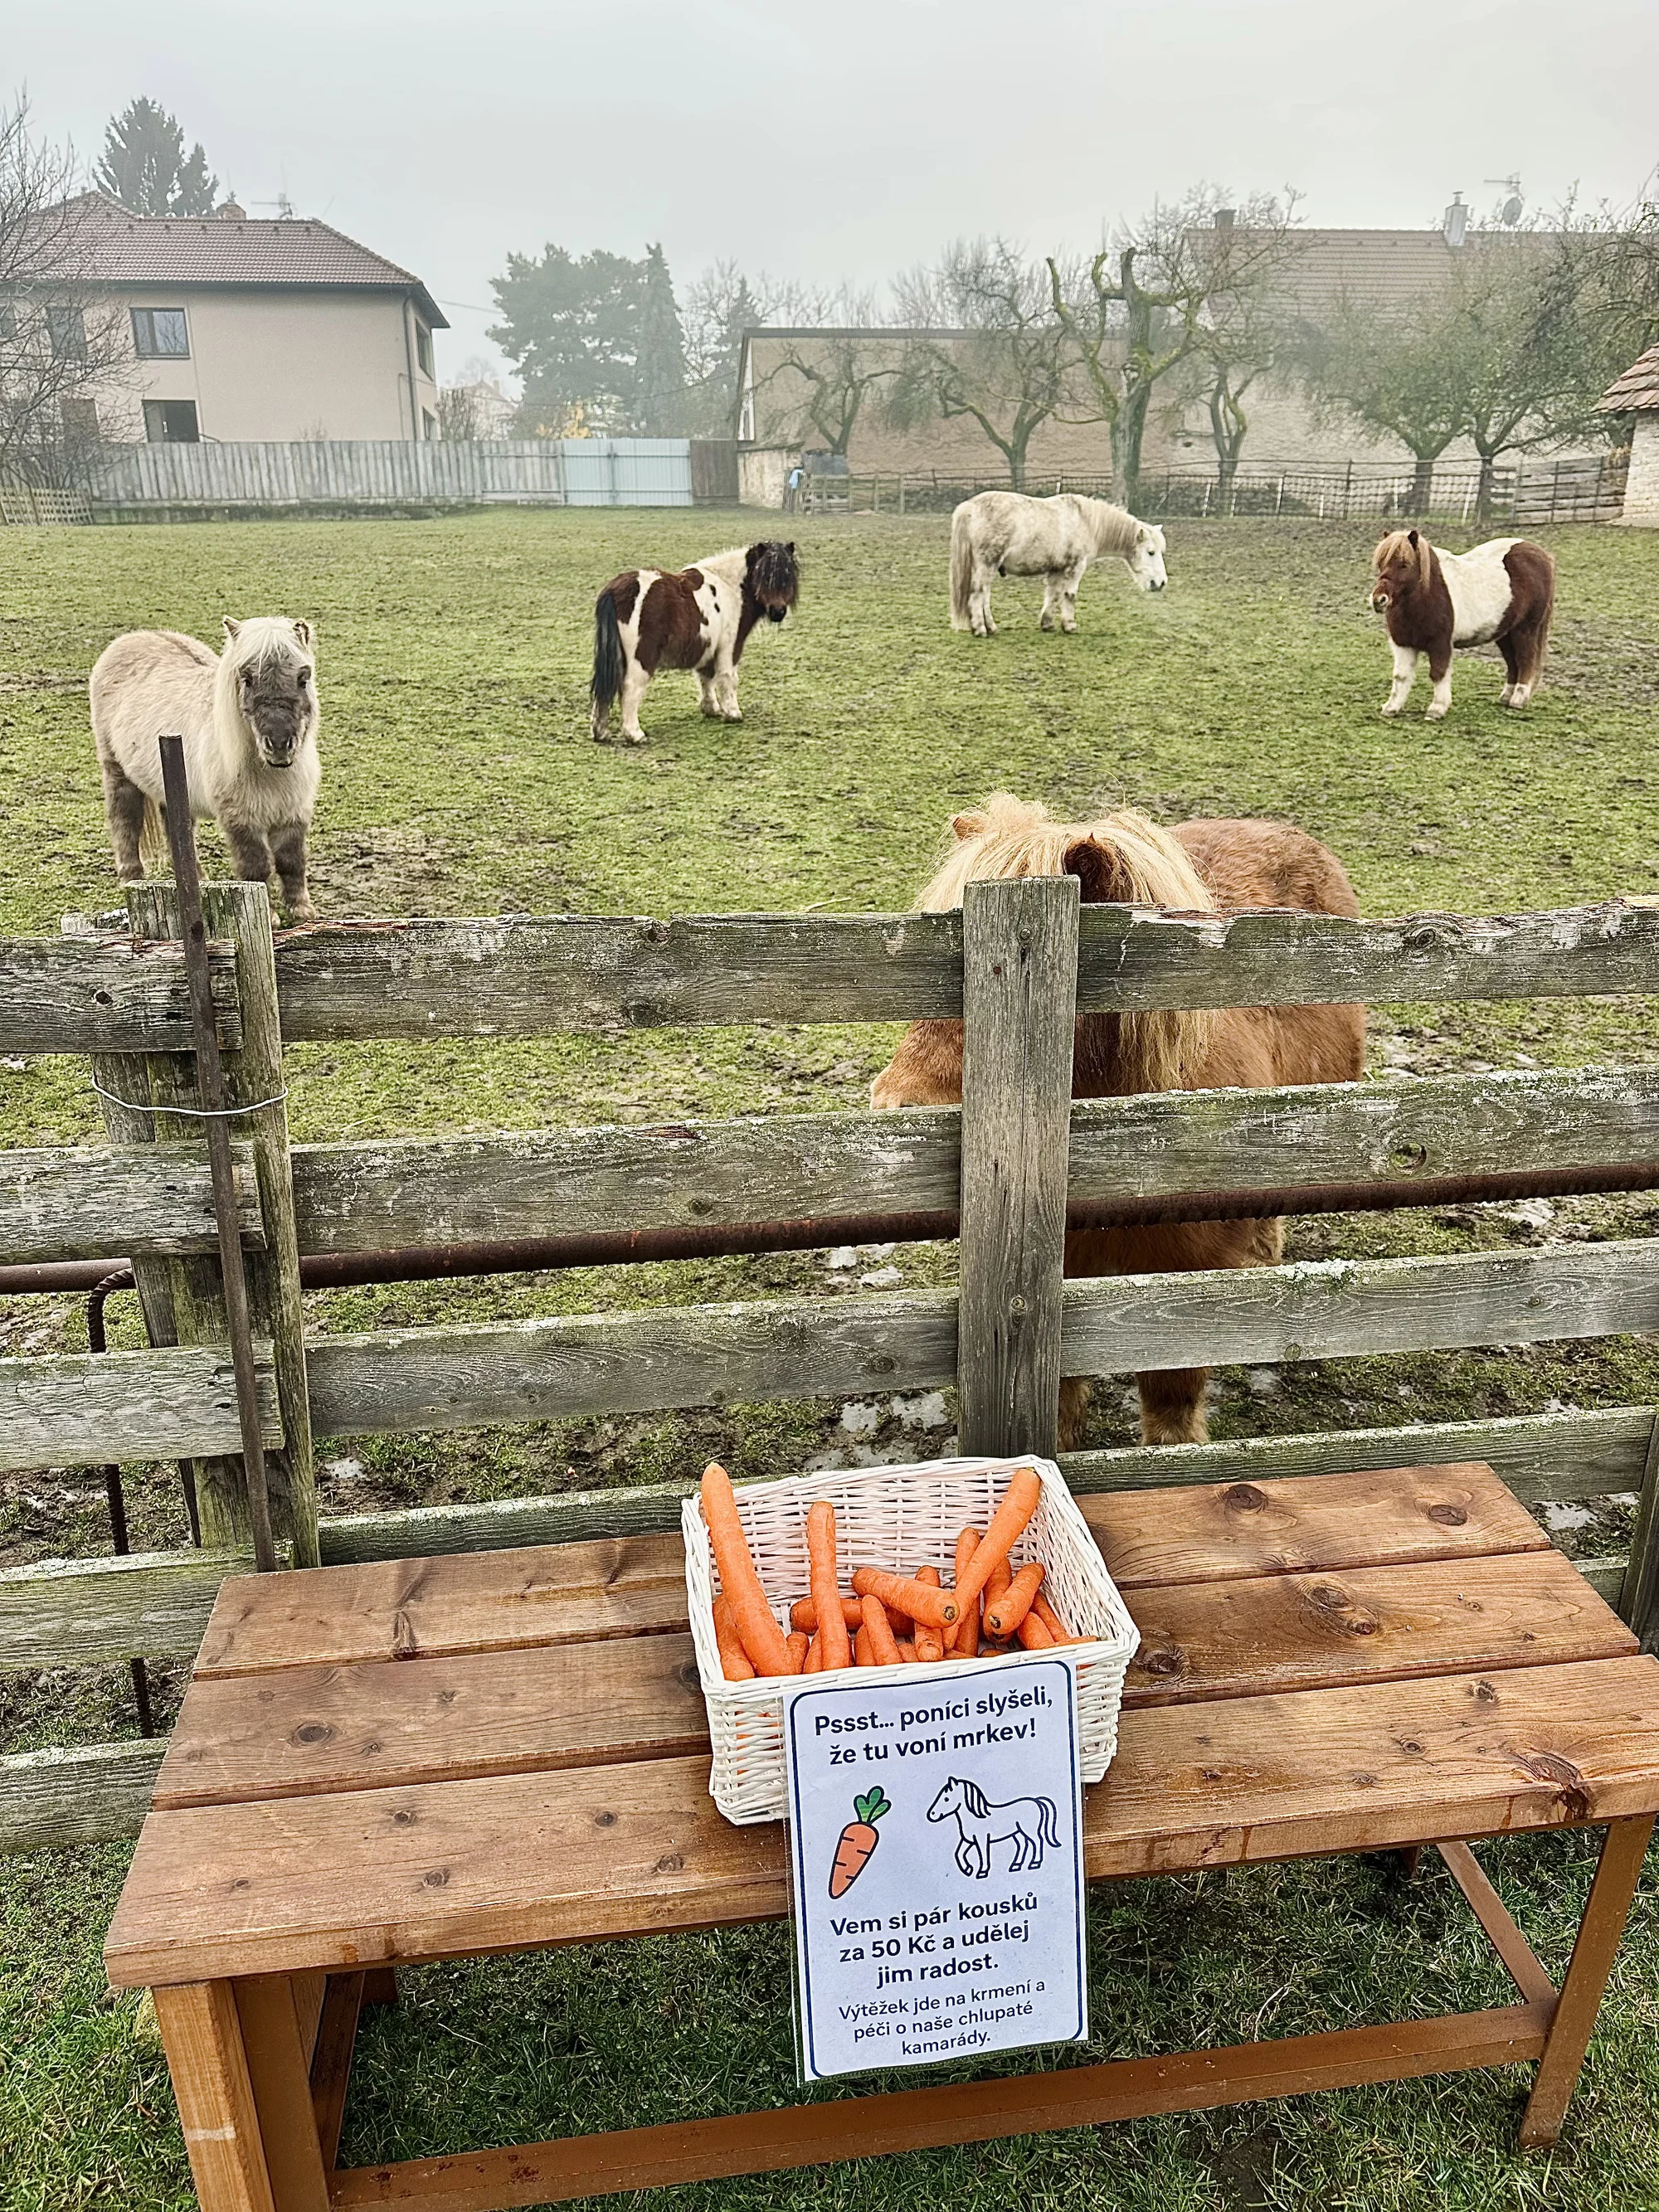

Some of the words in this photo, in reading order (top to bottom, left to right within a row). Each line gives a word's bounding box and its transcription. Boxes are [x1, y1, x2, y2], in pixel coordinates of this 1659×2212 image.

[900, 1697, 970, 1732] poníci
[975, 1685, 1053, 1718] slyšeli,
[830, 1744, 857, 1766] že
[862, 1743, 888, 1761] tu
[894, 1731, 946, 1757] voní
[953, 1717, 1036, 1749] mrkev!
[829, 1917, 882, 1937] Vem
[888, 1910, 907, 1930] si
[914, 1905, 951, 1932] pár
[958, 1891, 1038, 1921] kousků
[839, 1947, 865, 1963] za
[871, 1938, 901, 1958] 50
[907, 1933, 937, 1955] Kč
[942, 1936, 955, 1950] a
[961, 1919, 1029, 1947] udělej
[876, 1966, 913, 1990] jim
[920, 1953, 999, 1981] radost.
[838, 1998, 909, 2023] Výtěžek
[912, 1996, 941, 2016] jde
[945, 1994, 966, 2008] na
[971, 1979, 1031, 2003] krmení
[1035, 1981, 1045, 1992] a
[854, 2021, 890, 2044] péči
[896, 2024, 907, 2035] o
[912, 2015, 953, 2034] naše
[958, 2000, 1034, 2025] chlupaté
[902, 2029, 991, 2055] kamarády.
